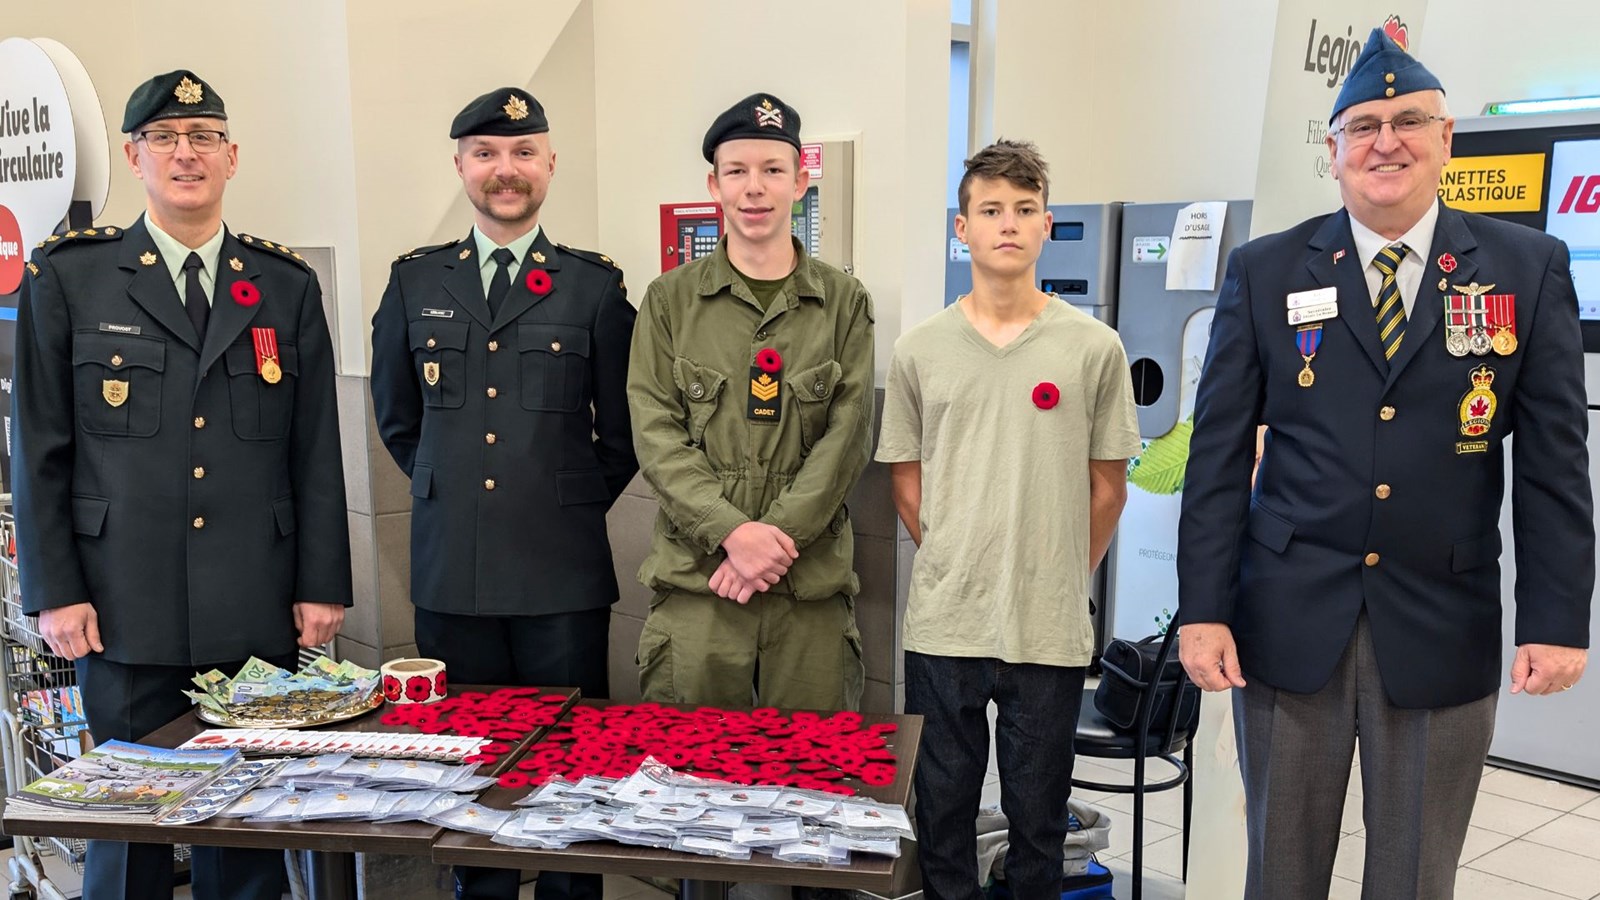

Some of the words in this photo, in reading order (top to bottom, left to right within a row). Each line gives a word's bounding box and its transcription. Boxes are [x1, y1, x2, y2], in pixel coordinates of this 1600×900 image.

[1304, 18, 1366, 88] Legio
[32, 97, 50, 133] la
[0, 141, 63, 183] irculaire
[1437, 186, 1526, 201] PLASTIQUE
[0, 236, 18, 260] ique
[753, 408, 776, 416] CADET
[1463, 417, 1489, 428] LEGION
[1462, 443, 1485, 452] VETERAN
[1138, 548, 1176, 561] PROTÉGEON
[249, 664, 266, 680] 20
